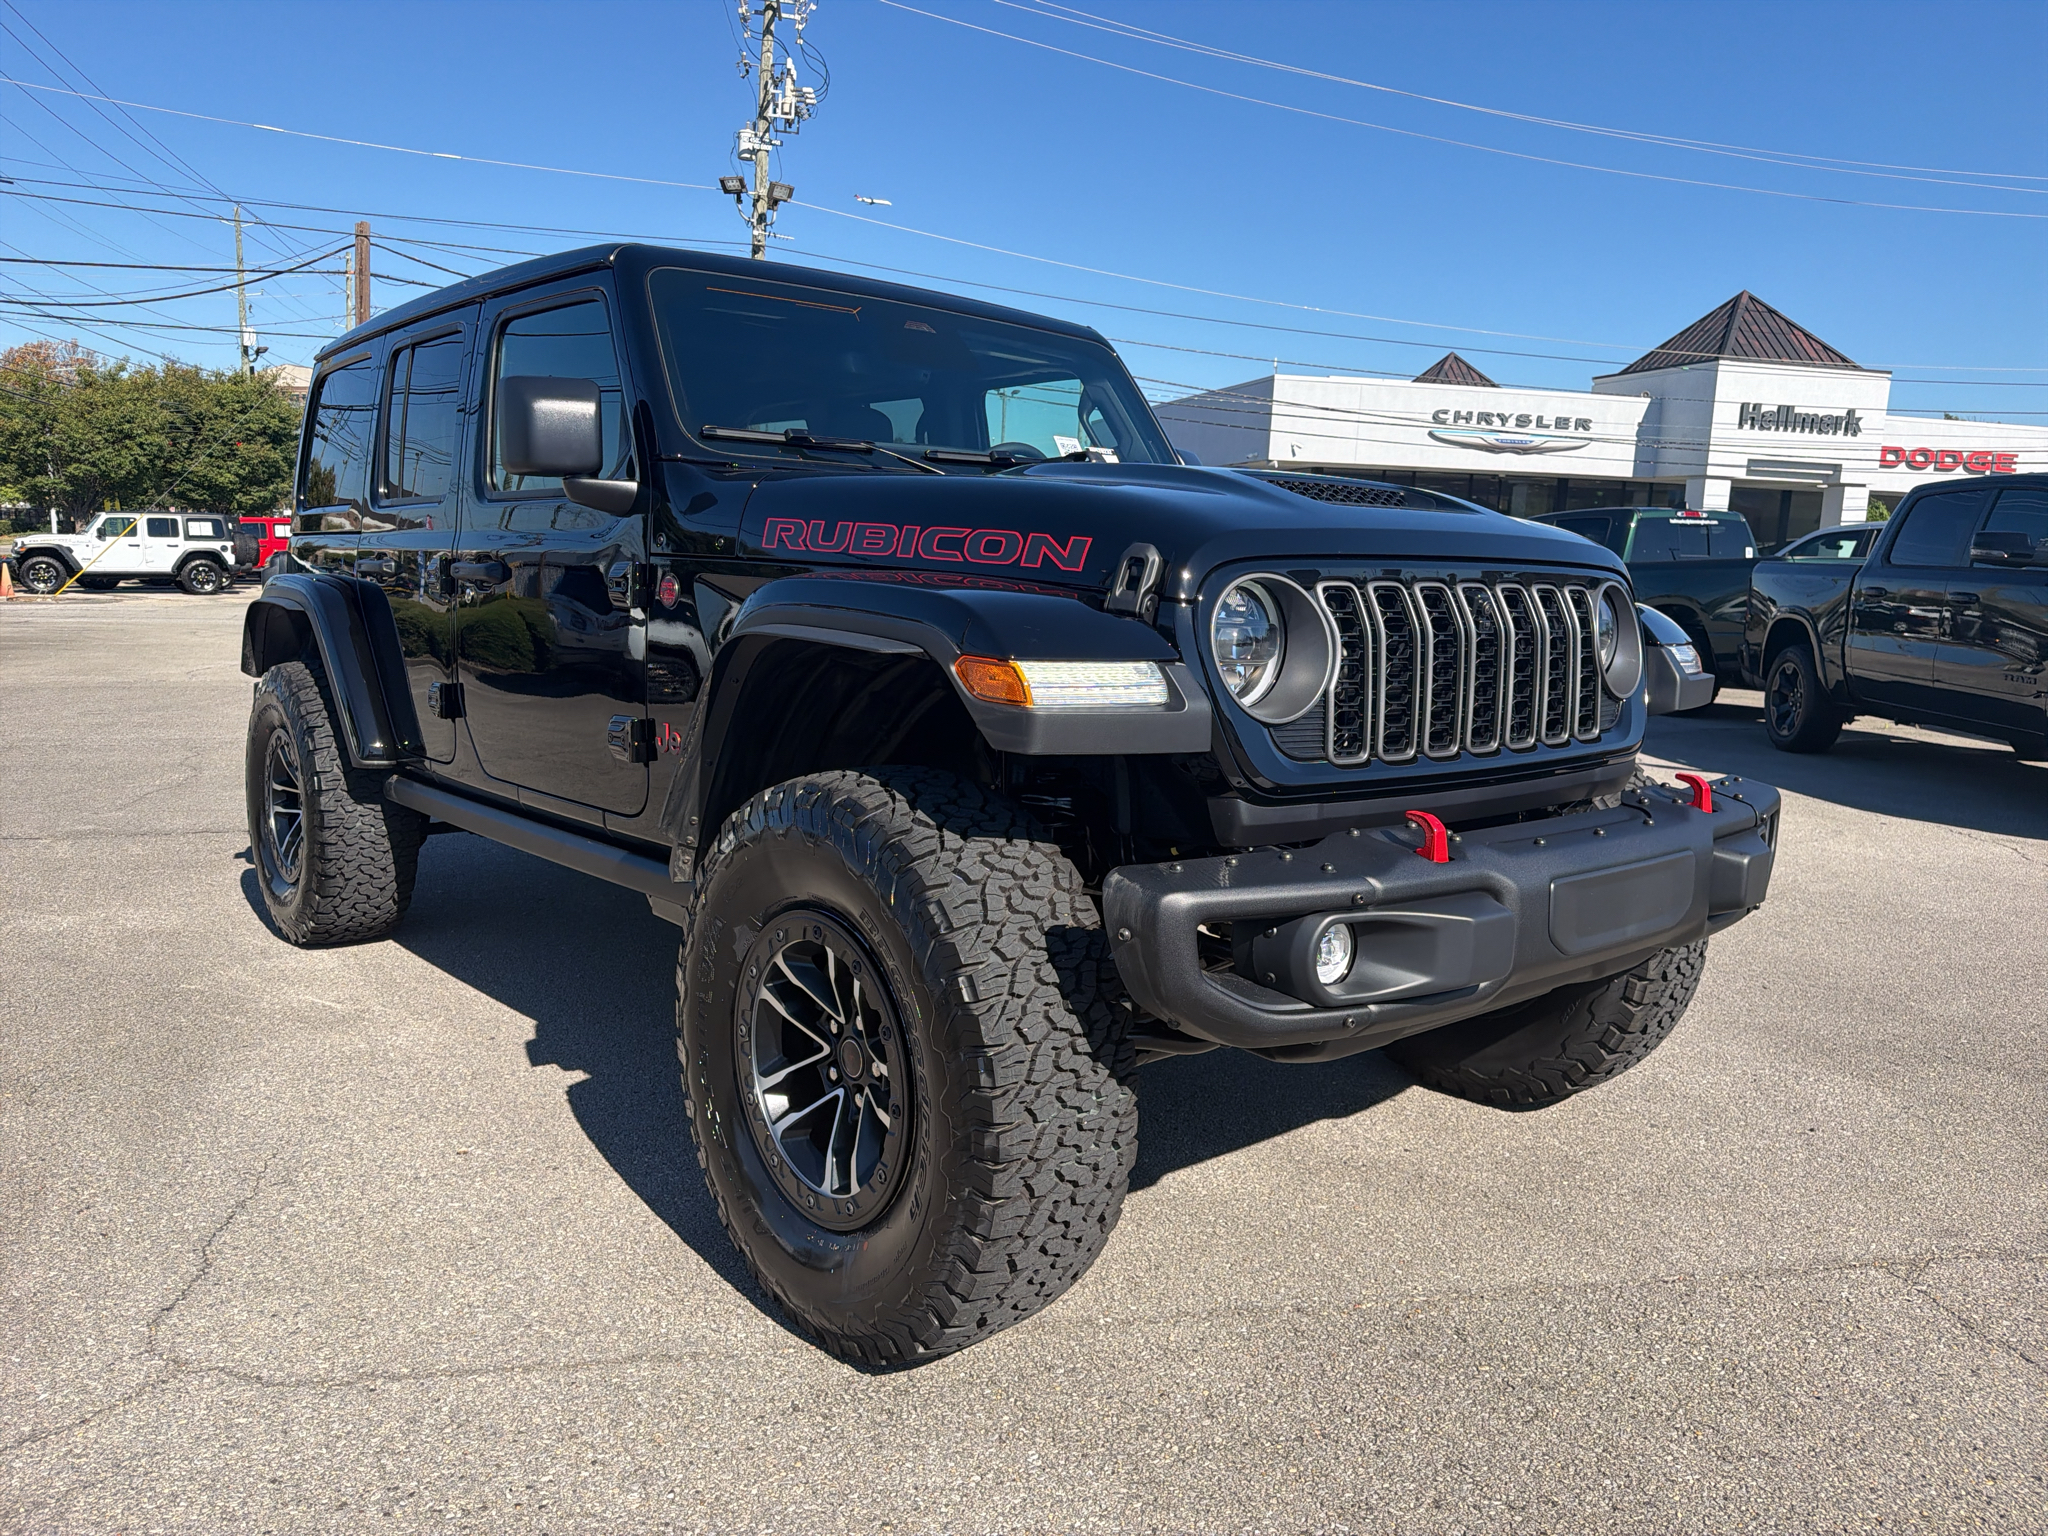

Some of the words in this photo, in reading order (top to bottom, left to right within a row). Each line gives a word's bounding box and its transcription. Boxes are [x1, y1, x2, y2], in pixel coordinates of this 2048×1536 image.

[1432, 409, 1593, 431] CHRYSLER
[1738, 402, 1863, 437] Hallmark
[1879, 446, 2019, 475] DODGE
[762, 518, 1093, 571] RUBICON
